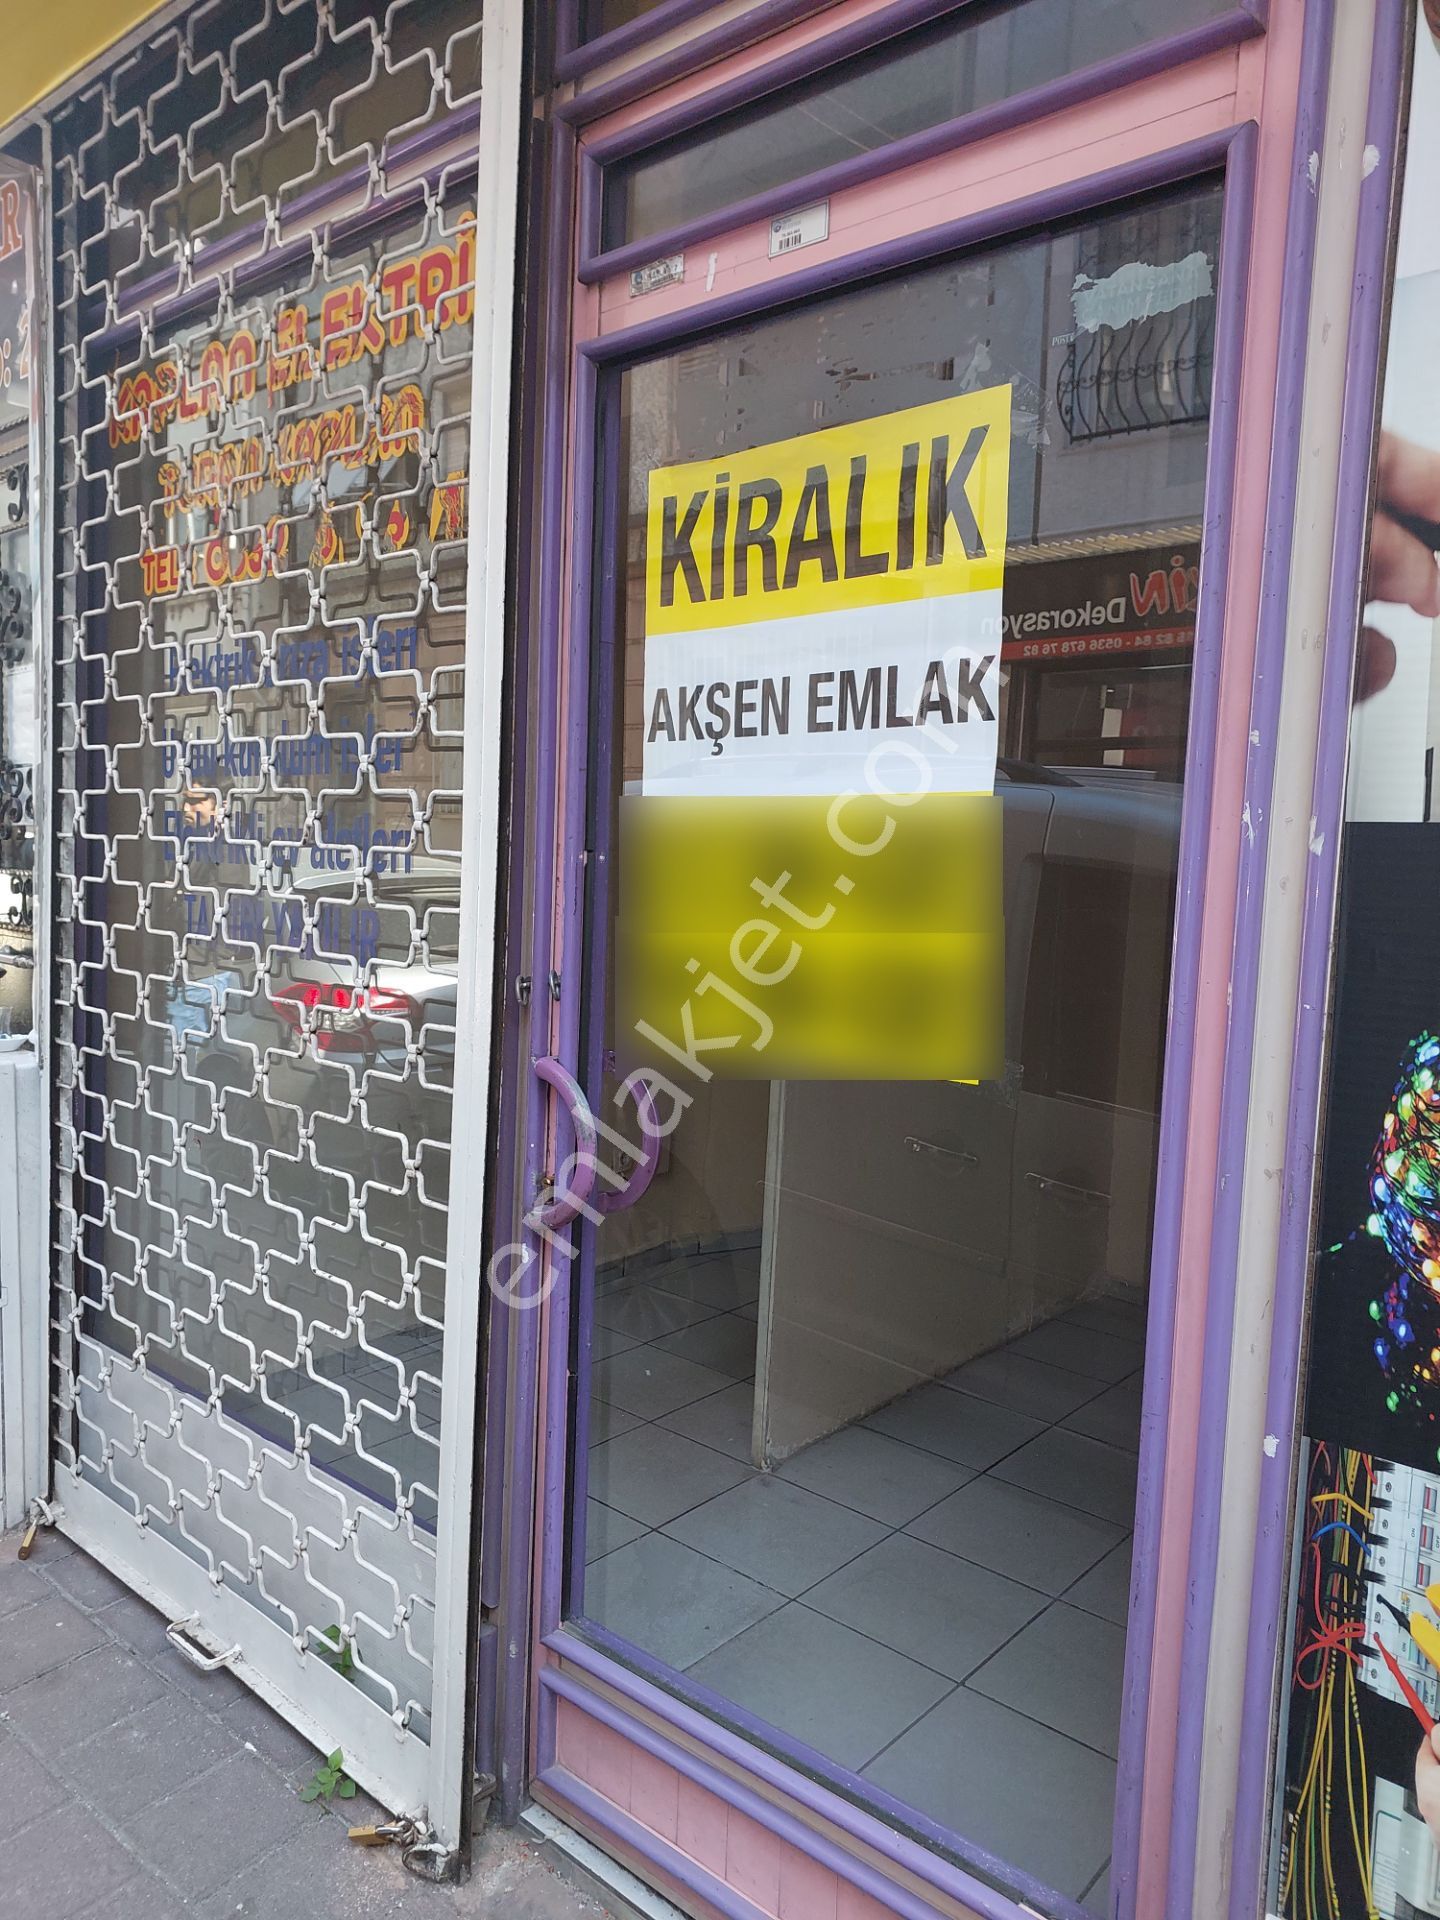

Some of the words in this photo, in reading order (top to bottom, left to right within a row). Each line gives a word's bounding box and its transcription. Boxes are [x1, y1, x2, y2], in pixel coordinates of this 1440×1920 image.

[660, 424, 990, 607] KİRALIK
[140, 546, 181, 596] TEL
[261, 638, 329, 688] rıza
[647, 676, 790, 755] AKŞEN
[807, 655, 996, 733] EMLAK
[163, 726, 217, 779] Udu
[163, 809, 263, 866] Elektikli
